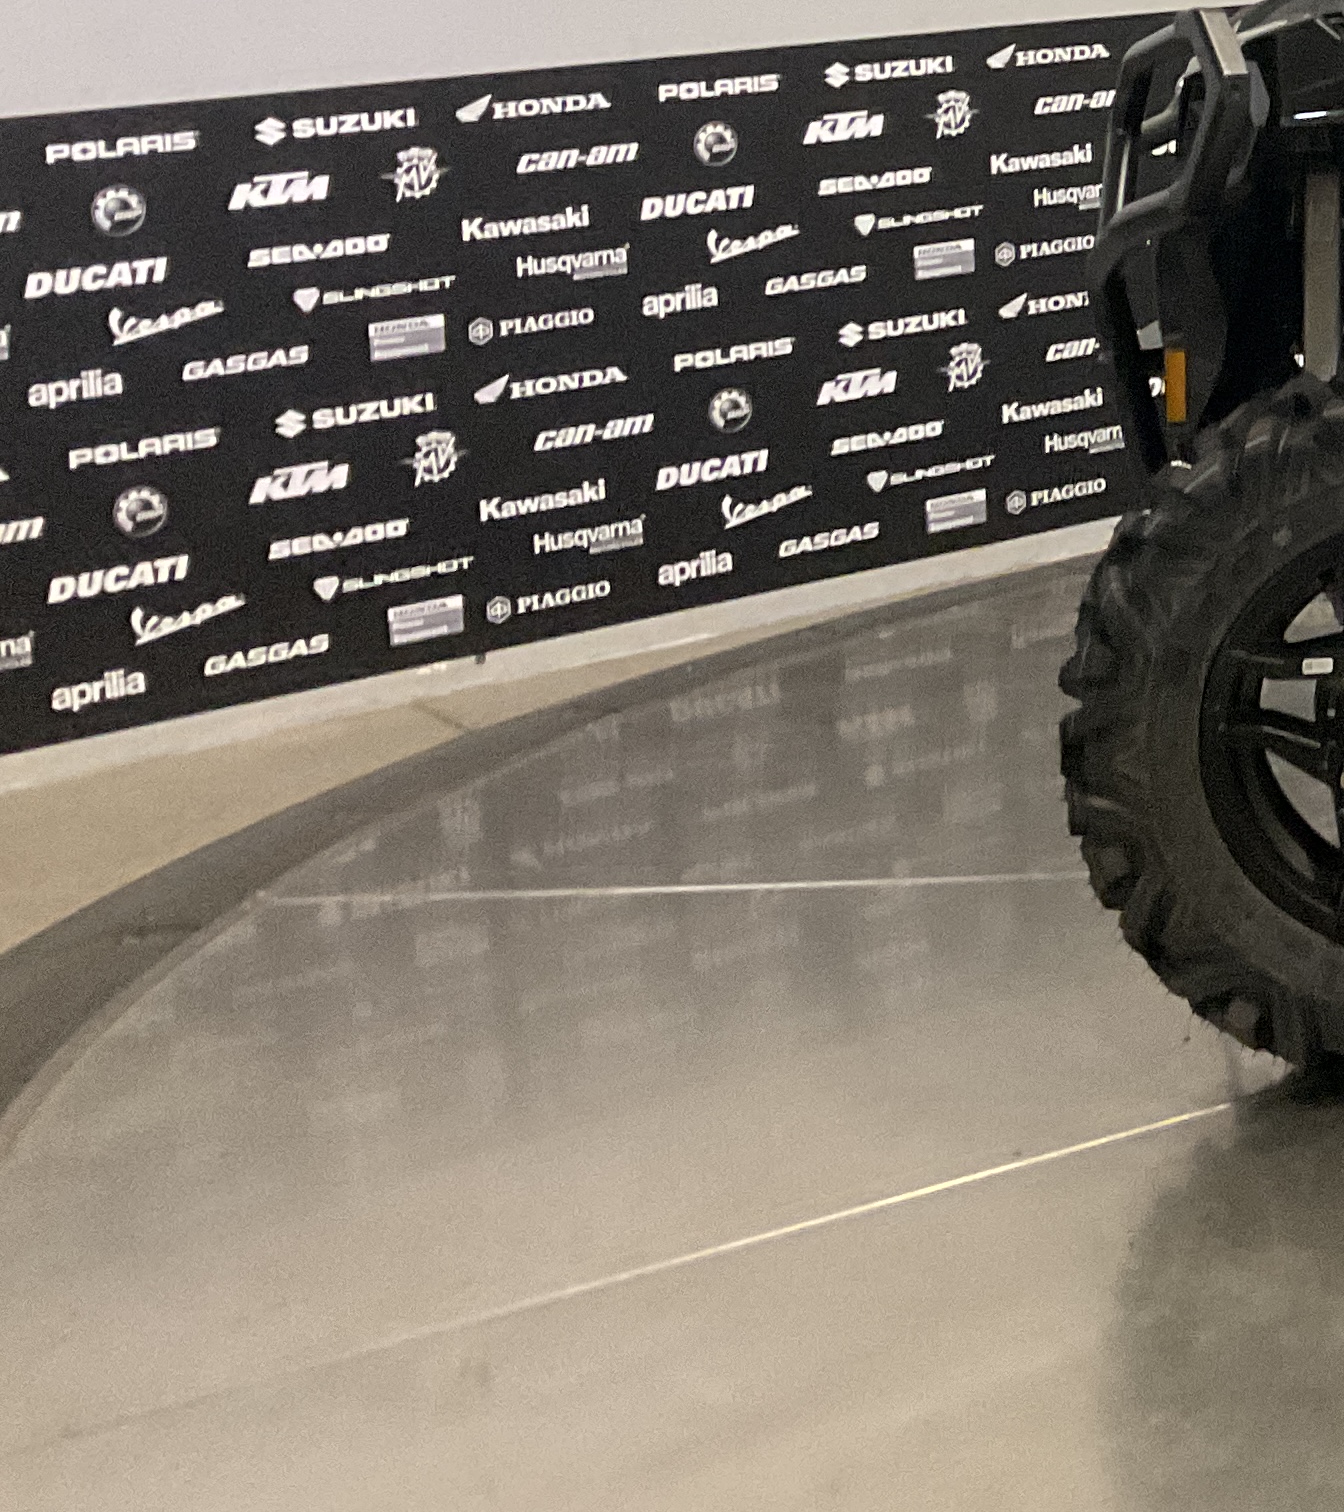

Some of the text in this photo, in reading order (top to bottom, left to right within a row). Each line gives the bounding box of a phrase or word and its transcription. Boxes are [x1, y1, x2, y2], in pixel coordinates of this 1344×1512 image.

[854, 55, 953, 82] SUZUKI
[1015, 43, 1110, 67] HONDA
[658, 73, 780, 102] POLARIS
[292, 107, 417, 139] SUZUKI
[492, 92, 612, 120] HONDA
[803, 110, 884, 145] KTM
[45, 130, 200, 165] POLARIS
[516, 142, 639, 174] can-am
[990, 142, 1092, 175] Kawasaki
[228, 170, 330, 211] KTM
[640, 184, 754, 221] DUCATI
[1033, 184, 1102, 208] Husqvar
[461, 204, 589, 241] Kawasaki
[877, 205, 984, 230] SLINGSHOT
[516, 244, 628, 278] Husqvarna
[707, 224, 800, 264] Vespa
[1019, 234, 1095, 259] PIAGGIO
[24, 256, 167, 299] DUCATI
[322, 275, 456, 306] SLINGSHOT
[765, 265, 866, 295] GASGAS
[642, 283, 718, 319] aprilia
[1027, 291, 1089, 315] HON
[109, 300, 224, 346] Vespa
[499, 308, 595, 337] PIAGGIO
[867, 308, 966, 340] SUZUKI
[182, 345, 309, 381] GASGAS
[674, 337, 795, 372] POLARIS
[28, 368, 123, 409] aprilia
[510, 366, 628, 399] HONDA
[816, 368, 897, 406] KTM
[312, 392, 436, 430] SUZUKI
[1002, 387, 1103, 424] Kawasaki
[69, 427, 220, 470] POLARIS
[534, 413, 654, 451] can-am
[1045, 425, 1126, 454] Husqvarn
[249, 460, 349, 505] KTM
[655, 448, 768, 491] DUCATI
[890, 454, 995, 485] SLINGSHOT
[480, 478, 606, 522] Kawasaki
[721, 486, 812, 529] Vespa
[1031, 478, 1107, 506] PIAGGIO
[533, 517, 645, 554] Husqvarna
[779, 522, 879, 558] GASGAS
[47, 554, 190, 604] DUCATI
[342, 556, 474, 593] SLINGSHOT
[658, 549, 733, 587] aprilia
[517, 580, 611, 614] PIAGGIO
[131, 594, 245, 646] Vespa
[204, 634, 329, 677] GASGAS
[52, 668, 146, 712] aprilia
